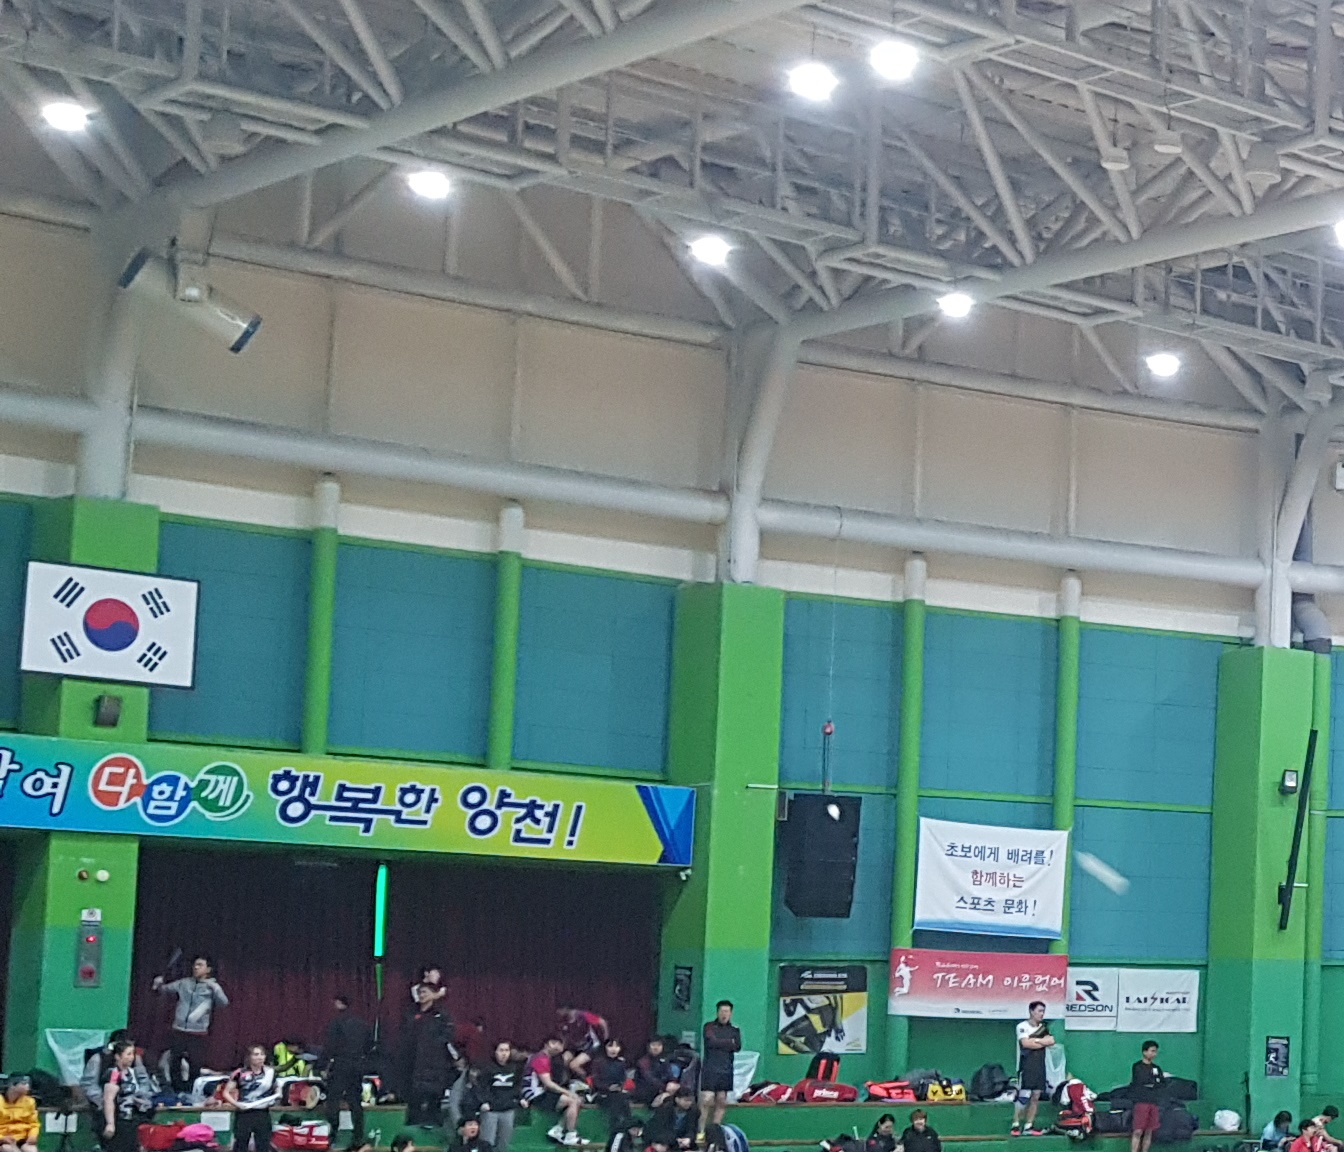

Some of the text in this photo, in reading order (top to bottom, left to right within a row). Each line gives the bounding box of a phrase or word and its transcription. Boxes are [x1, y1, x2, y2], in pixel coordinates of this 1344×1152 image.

[97, 765, 241, 817] 다함께
[269, 768, 440, 836] 행복한
[458, 783, 587, 849] 양천!
[945, 842, 1054, 867] 초보에게 배려를!
[971, 869, 1025, 888] 함께하는
[955, 896, 995, 912] 스포츠
[932, 972, 995, 989] TEAM
